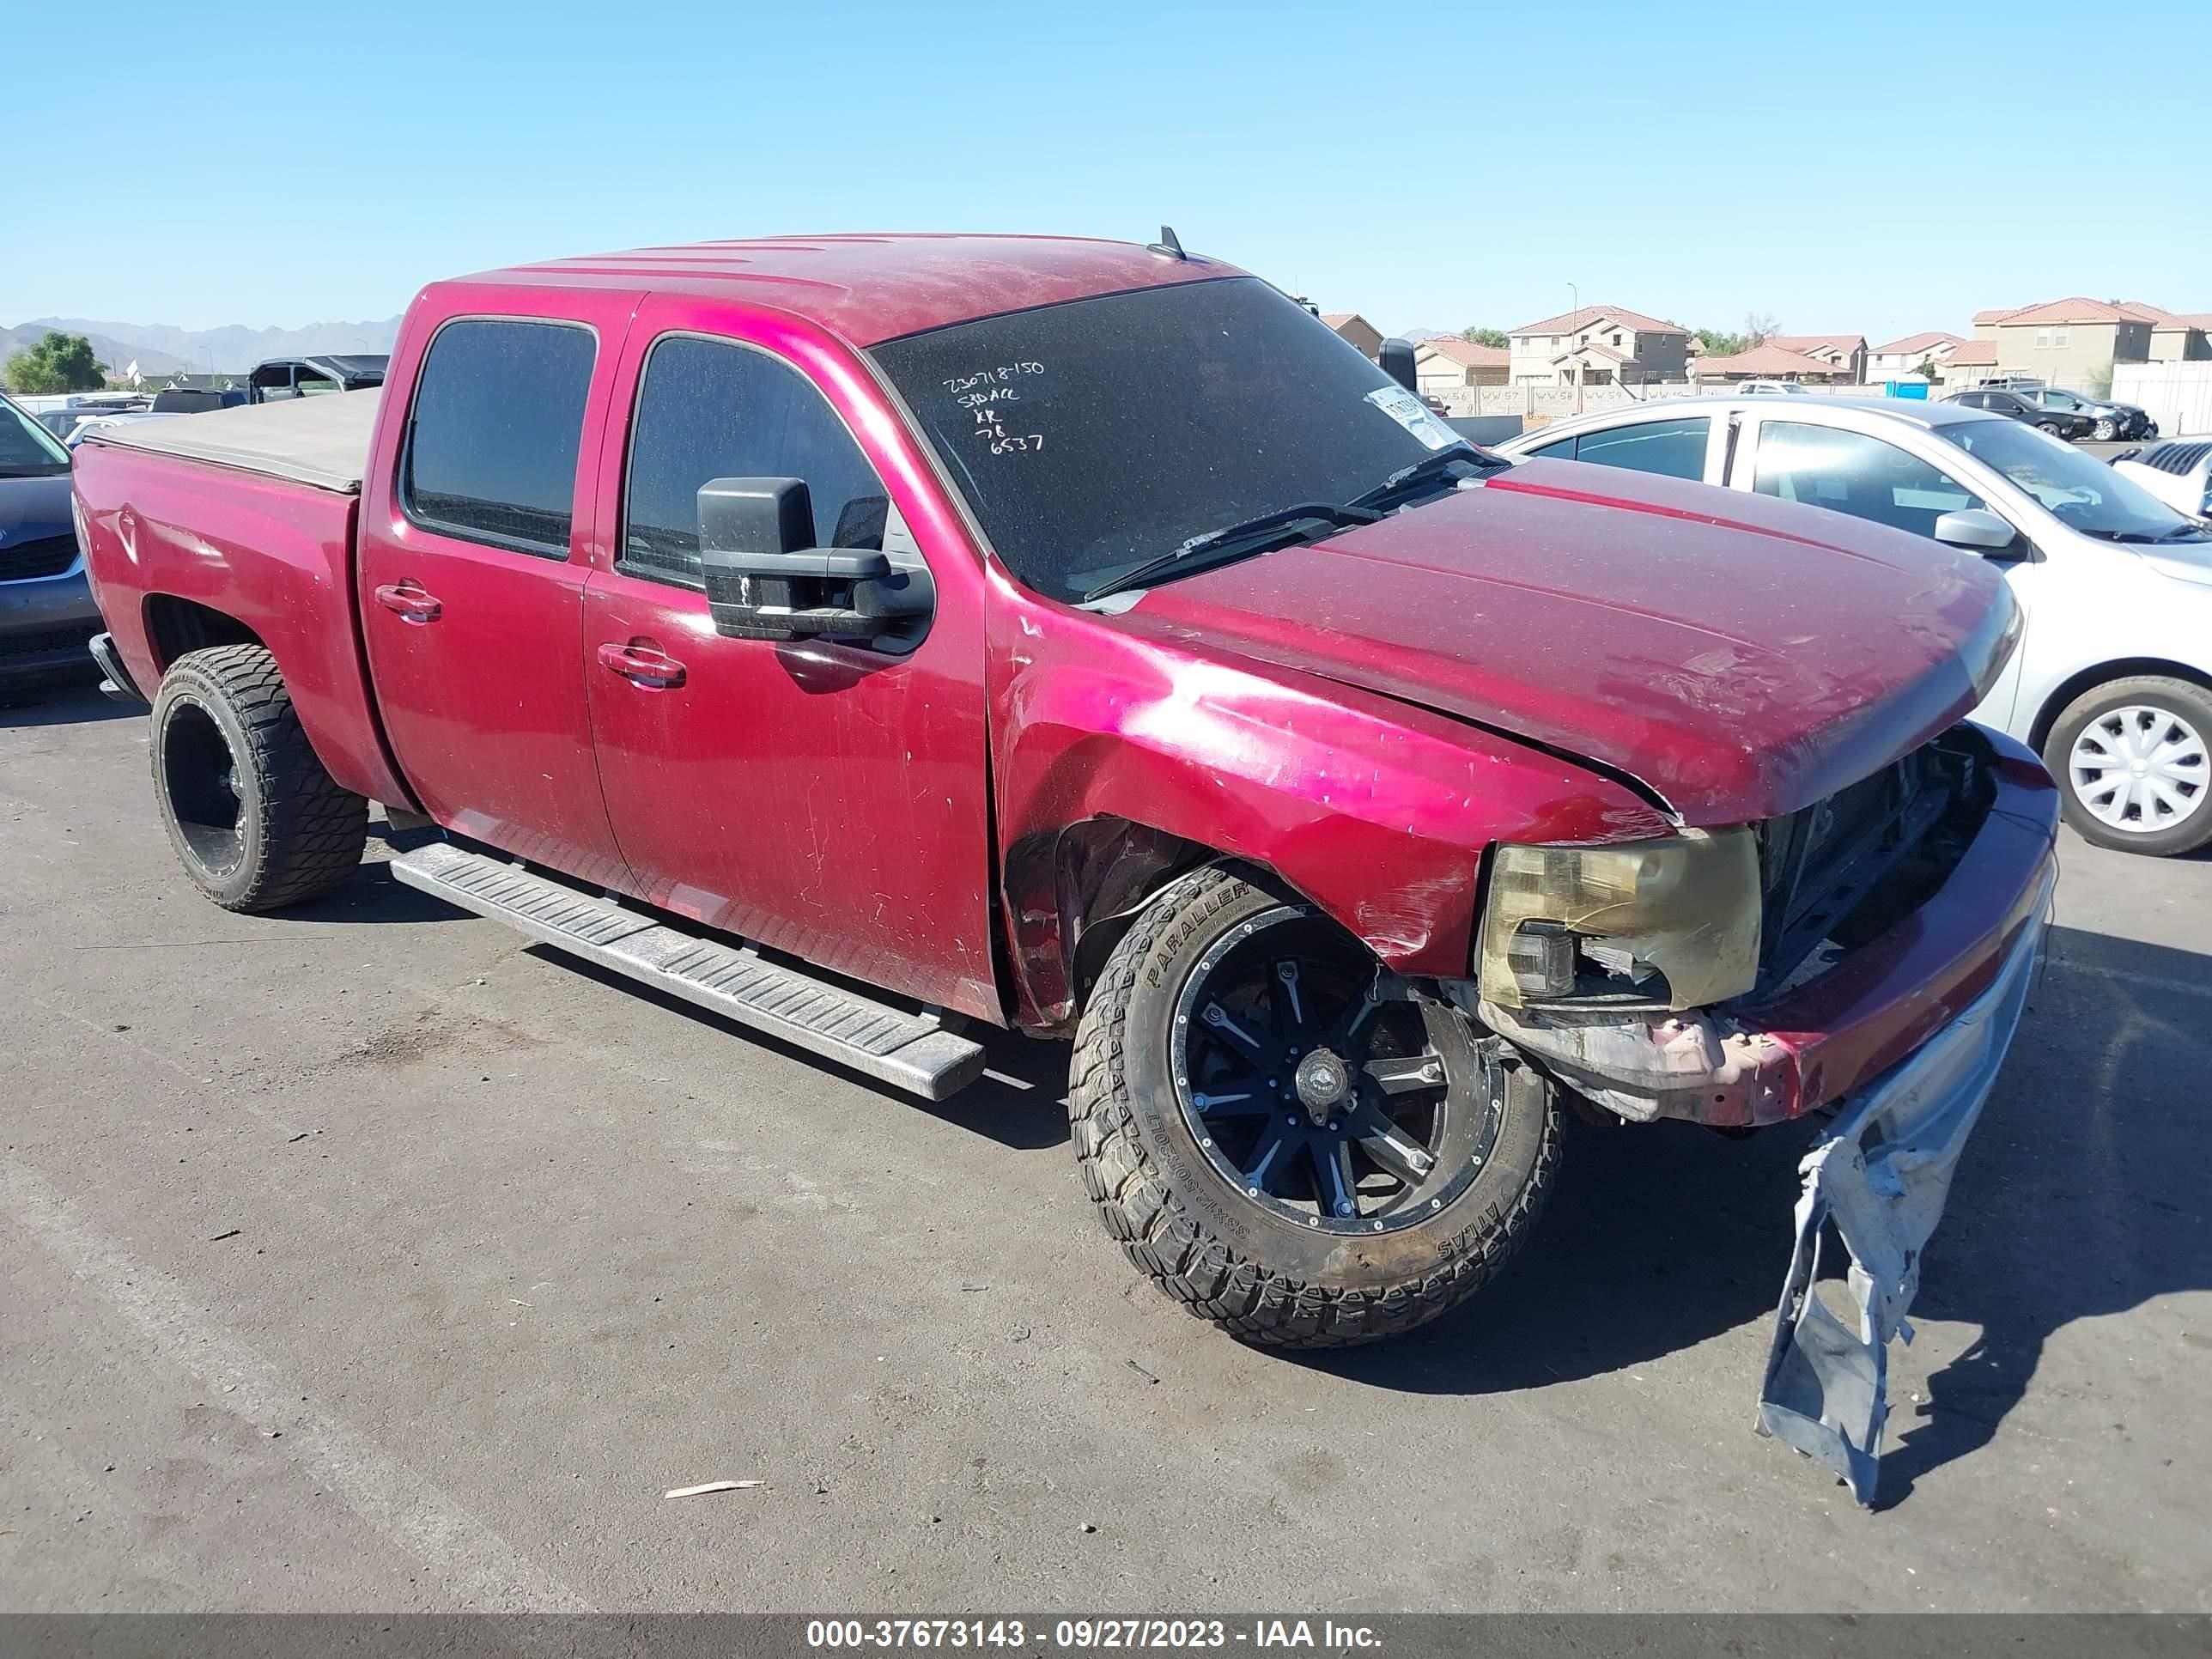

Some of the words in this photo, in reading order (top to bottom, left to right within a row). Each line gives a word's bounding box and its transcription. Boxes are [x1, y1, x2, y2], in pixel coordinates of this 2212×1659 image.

[943, 362, 1044, 393] 230718-150
[990, 434, 1042, 454] 6537
[1146, 880, 1250, 988] PARALLER
[1436, 1200, 1502, 1260] ATLAS
